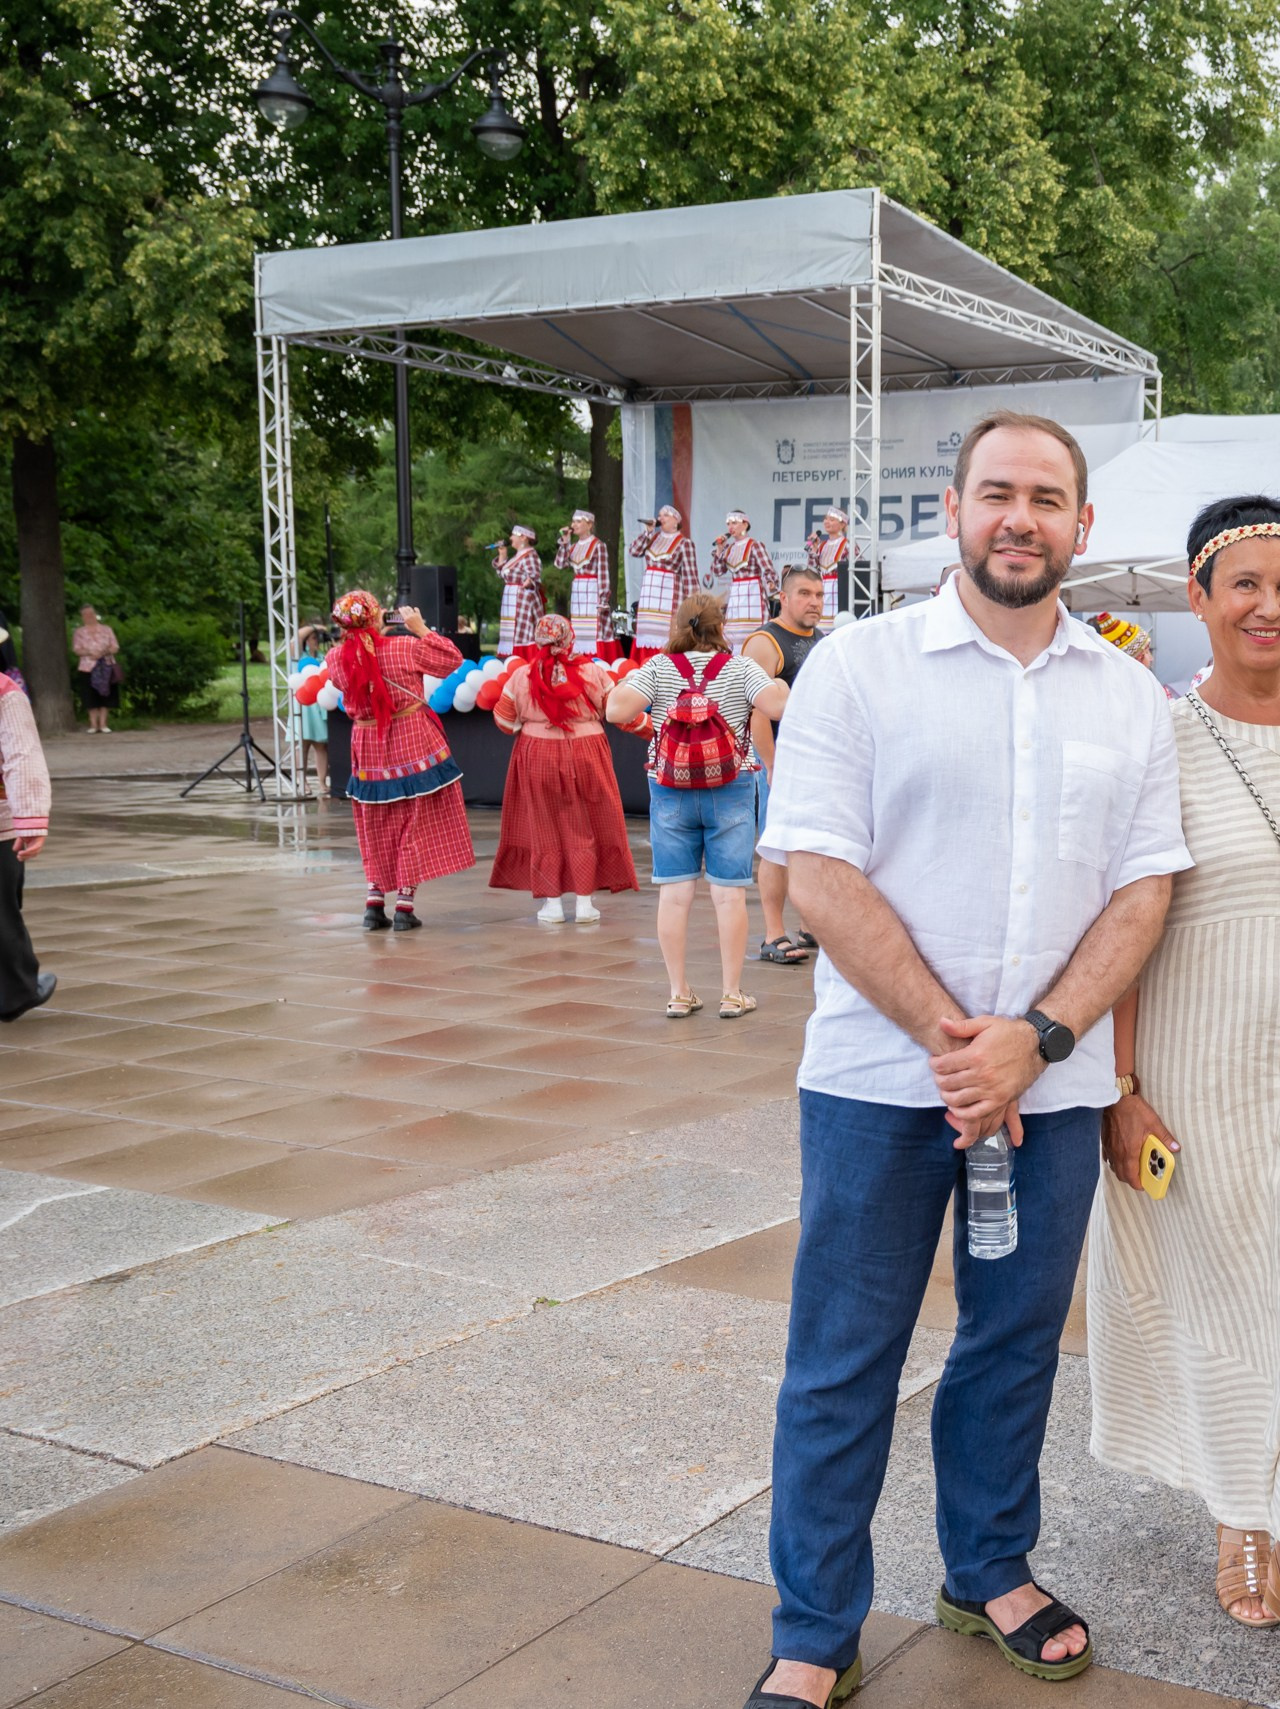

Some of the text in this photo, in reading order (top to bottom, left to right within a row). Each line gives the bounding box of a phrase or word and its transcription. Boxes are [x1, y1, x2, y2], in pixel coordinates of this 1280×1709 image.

[772, 465, 956, 483] ПЕТЕРБУРГ. АРОНИЯ КУЛЬ
[773, 494, 947, 542] ГЕРБЕ
